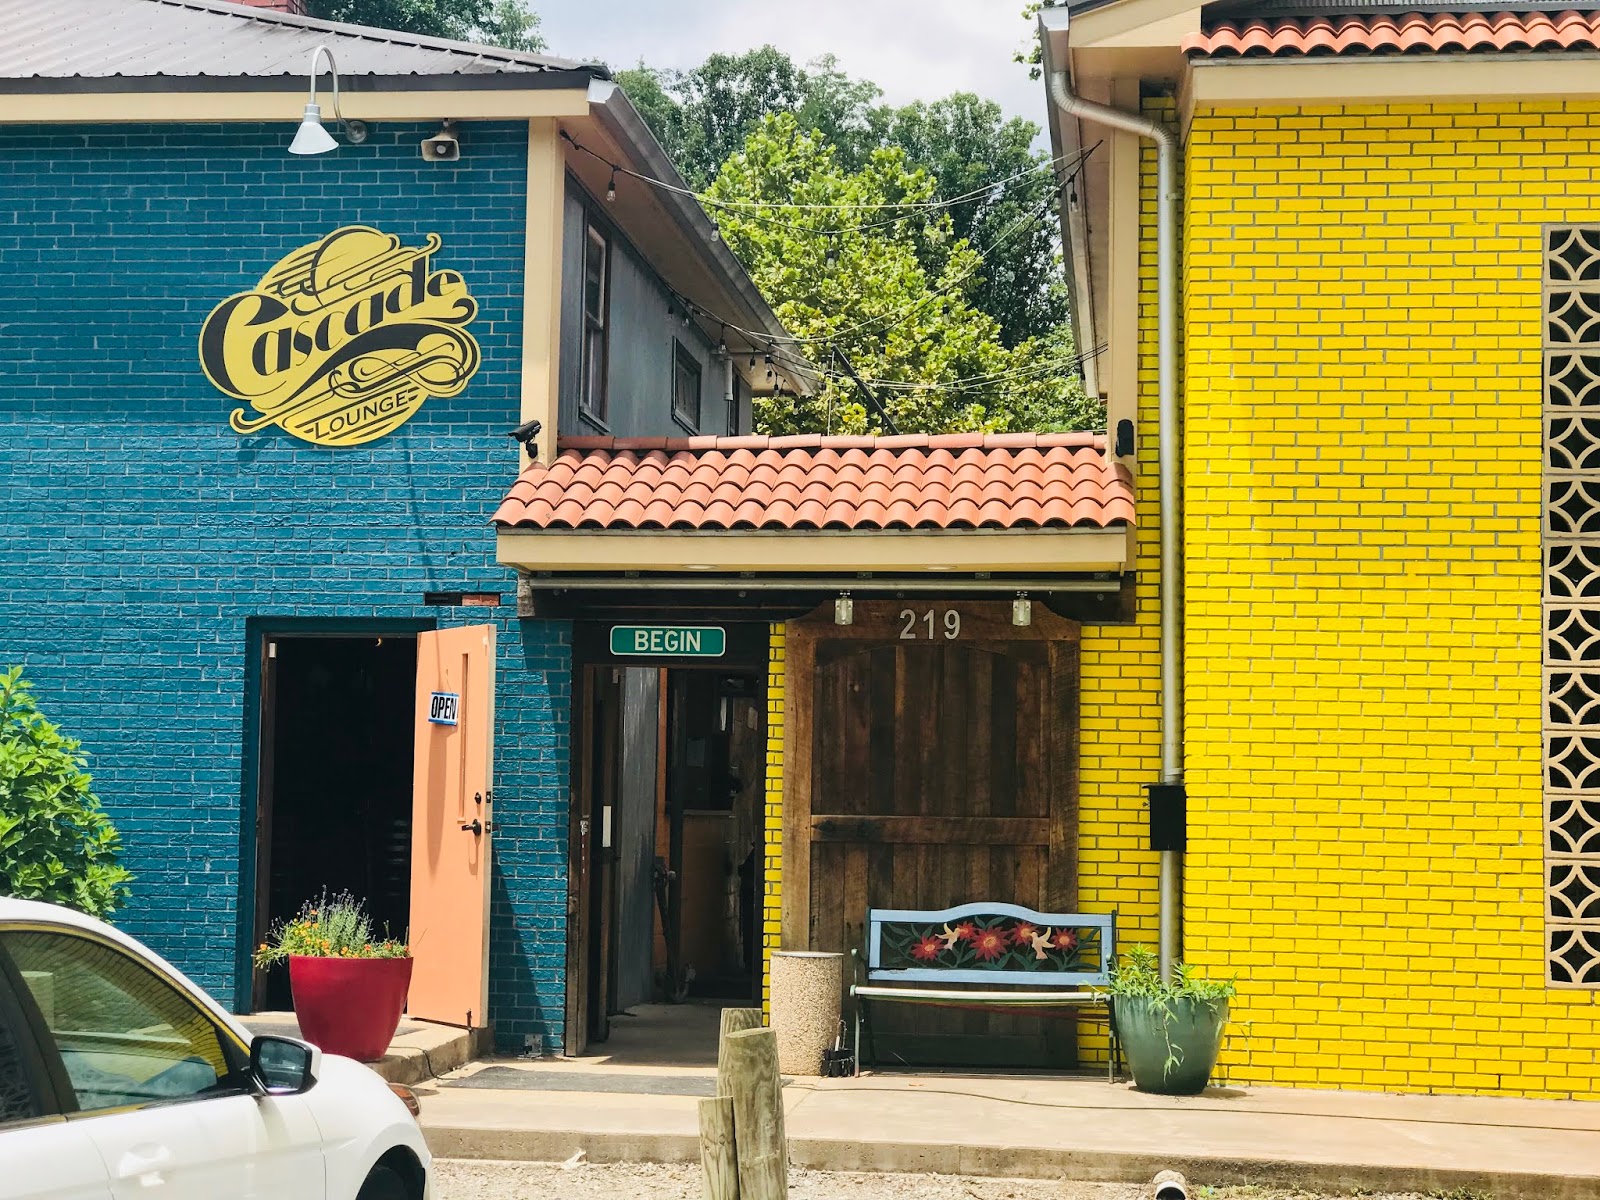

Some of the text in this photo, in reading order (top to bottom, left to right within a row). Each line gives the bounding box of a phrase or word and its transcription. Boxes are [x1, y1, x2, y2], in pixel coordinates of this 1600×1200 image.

[201, 253, 463, 397] Cascade
[313, 391, 409, 439] LOUNGE
[899, 609, 961, 640] 219
[634, 630, 701, 652] BEGIN
[430, 695, 457, 720] OPEN
